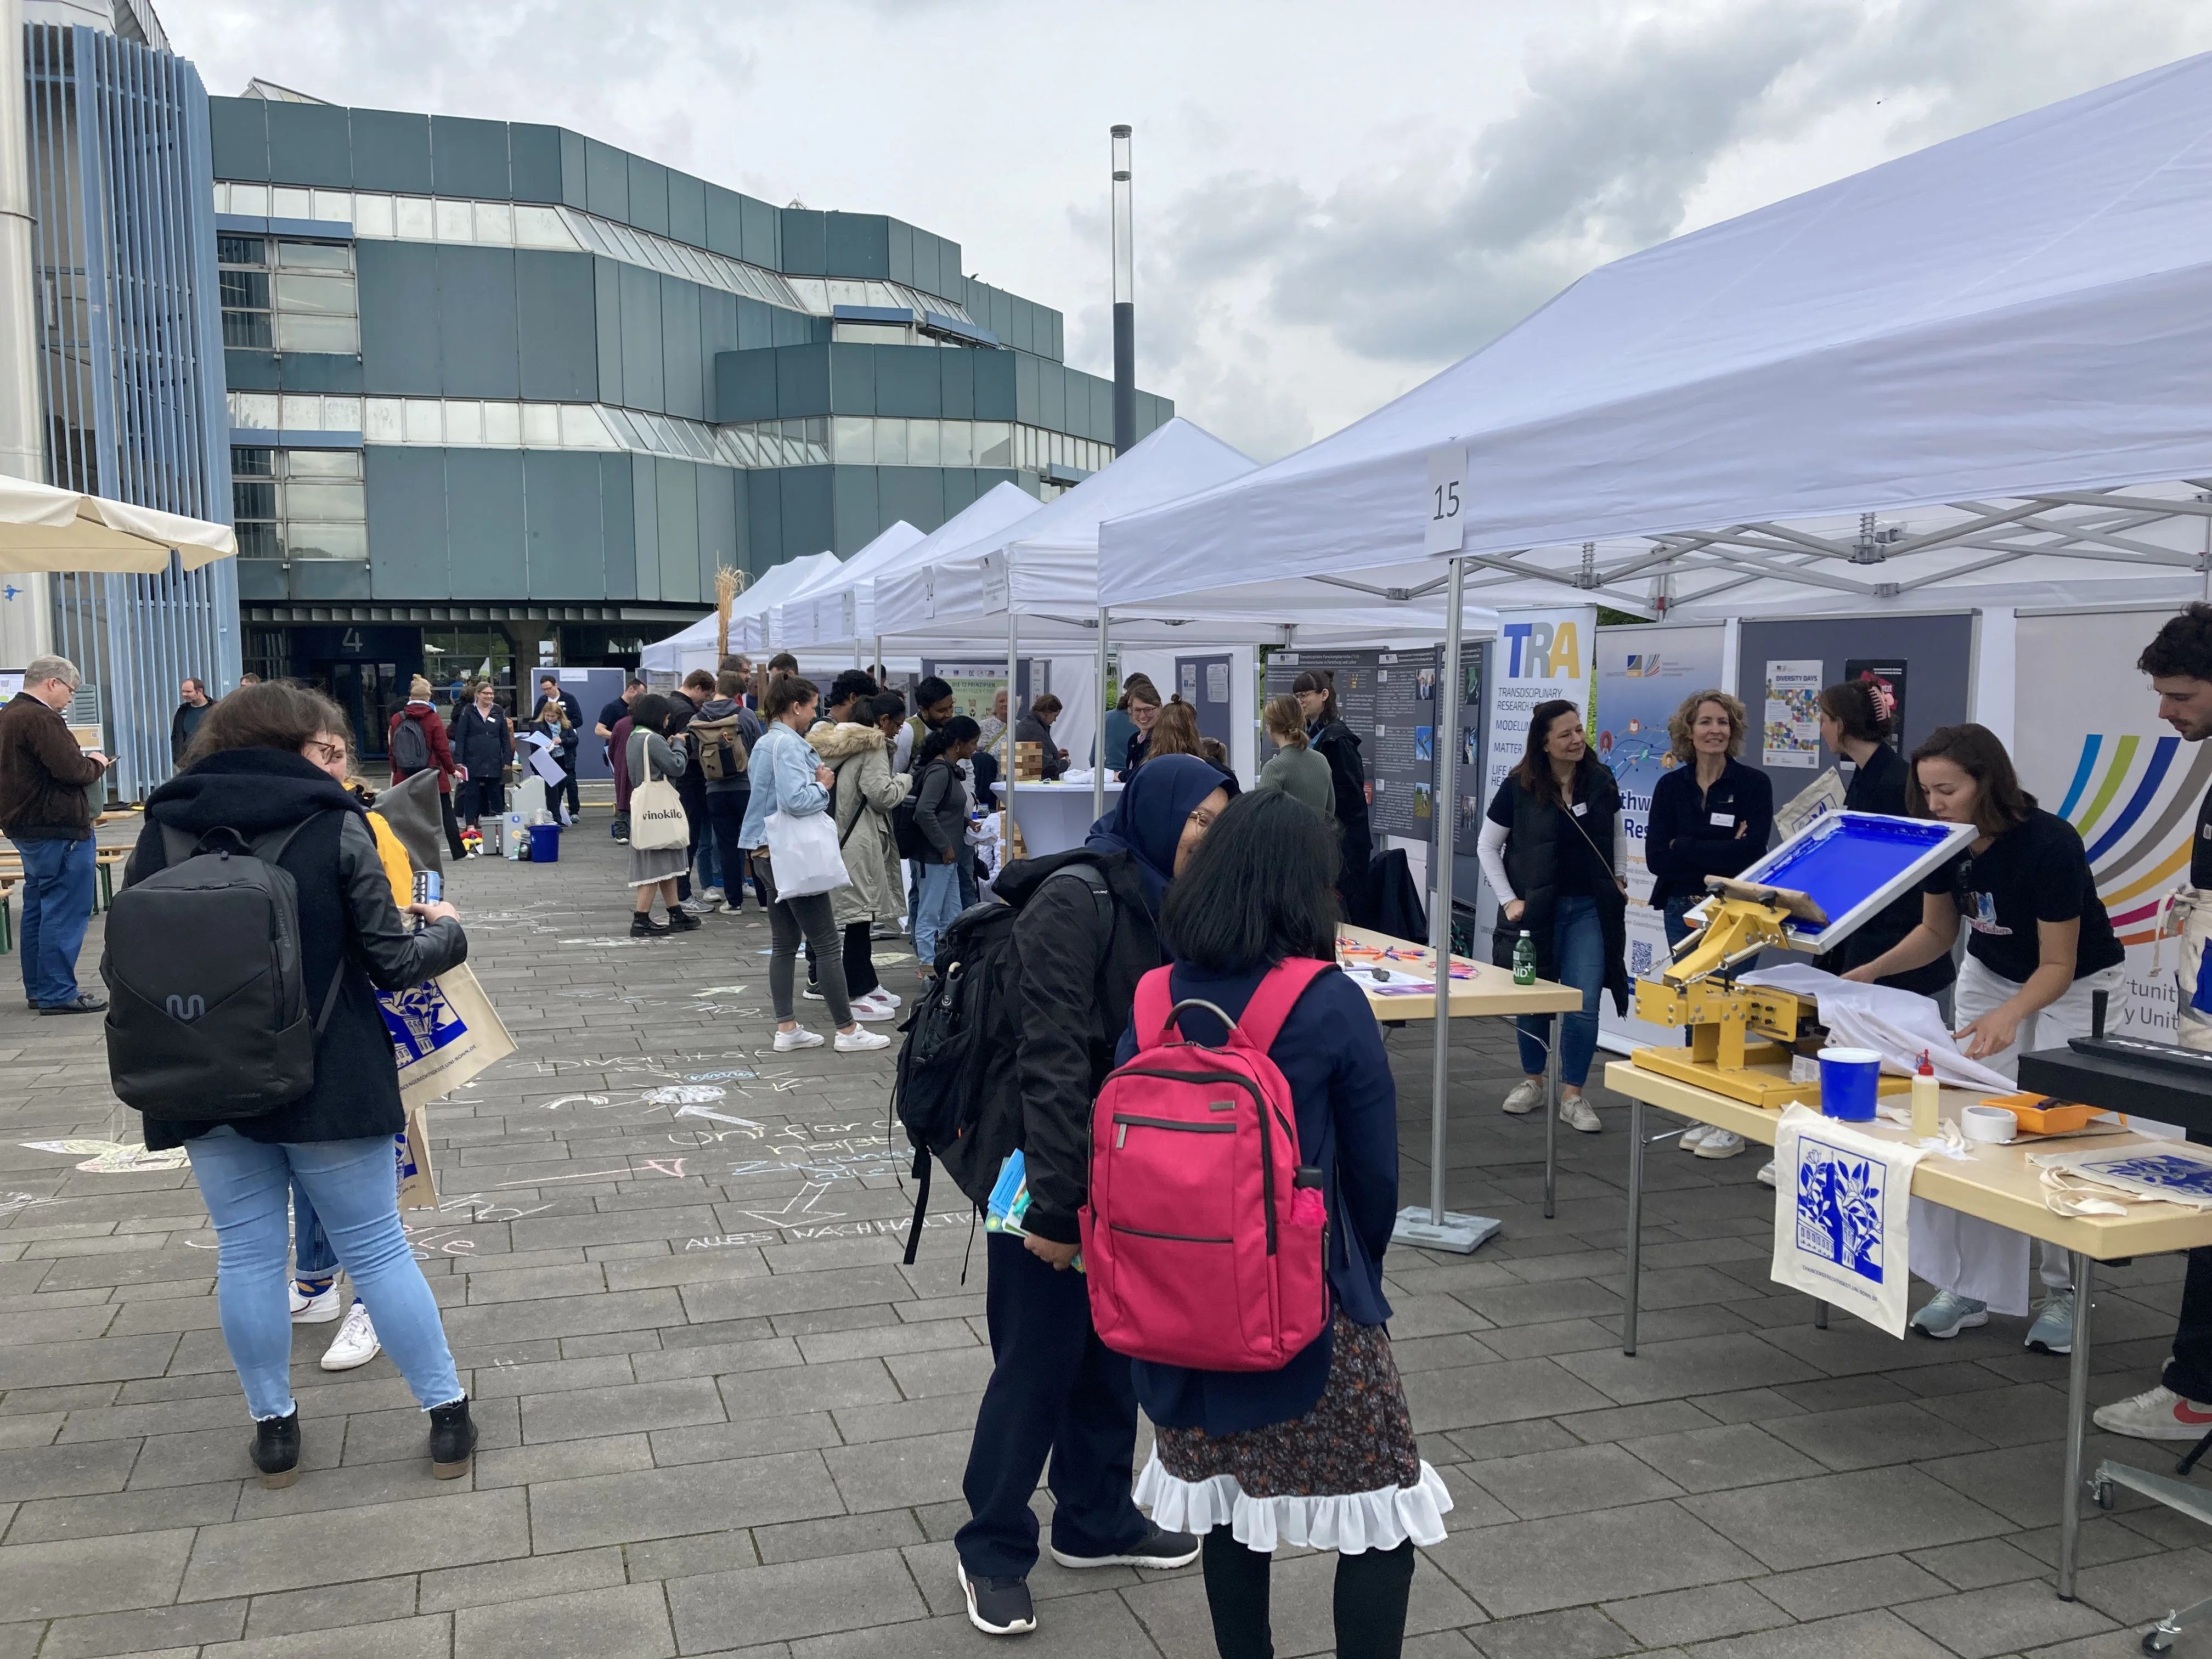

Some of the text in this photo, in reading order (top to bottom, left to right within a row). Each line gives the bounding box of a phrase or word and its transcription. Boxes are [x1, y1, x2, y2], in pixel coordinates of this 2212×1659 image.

[1433, 481, 1459, 521] 15
[342, 628, 363, 652] 4
[1504, 622, 1580, 679] TRA
[1498, 687, 1563, 698] TRANSDISCIPLINARY
[1497, 701, 1530, 711] RESEARCH
[1496, 720, 1531, 731] MODELLIN
[1494, 742, 1522, 754] MATTER
[1492, 764, 1507, 776] LIFE
[1621, 791, 1651, 811] thw
[642, 809, 682, 820] vinokilo
[1624, 819, 1649, 840] Res
[2130, 979, 2176, 1003] tunit
[2140, 1006, 2178, 1030] Unit
[685, 1232, 773, 1250] ALLES
